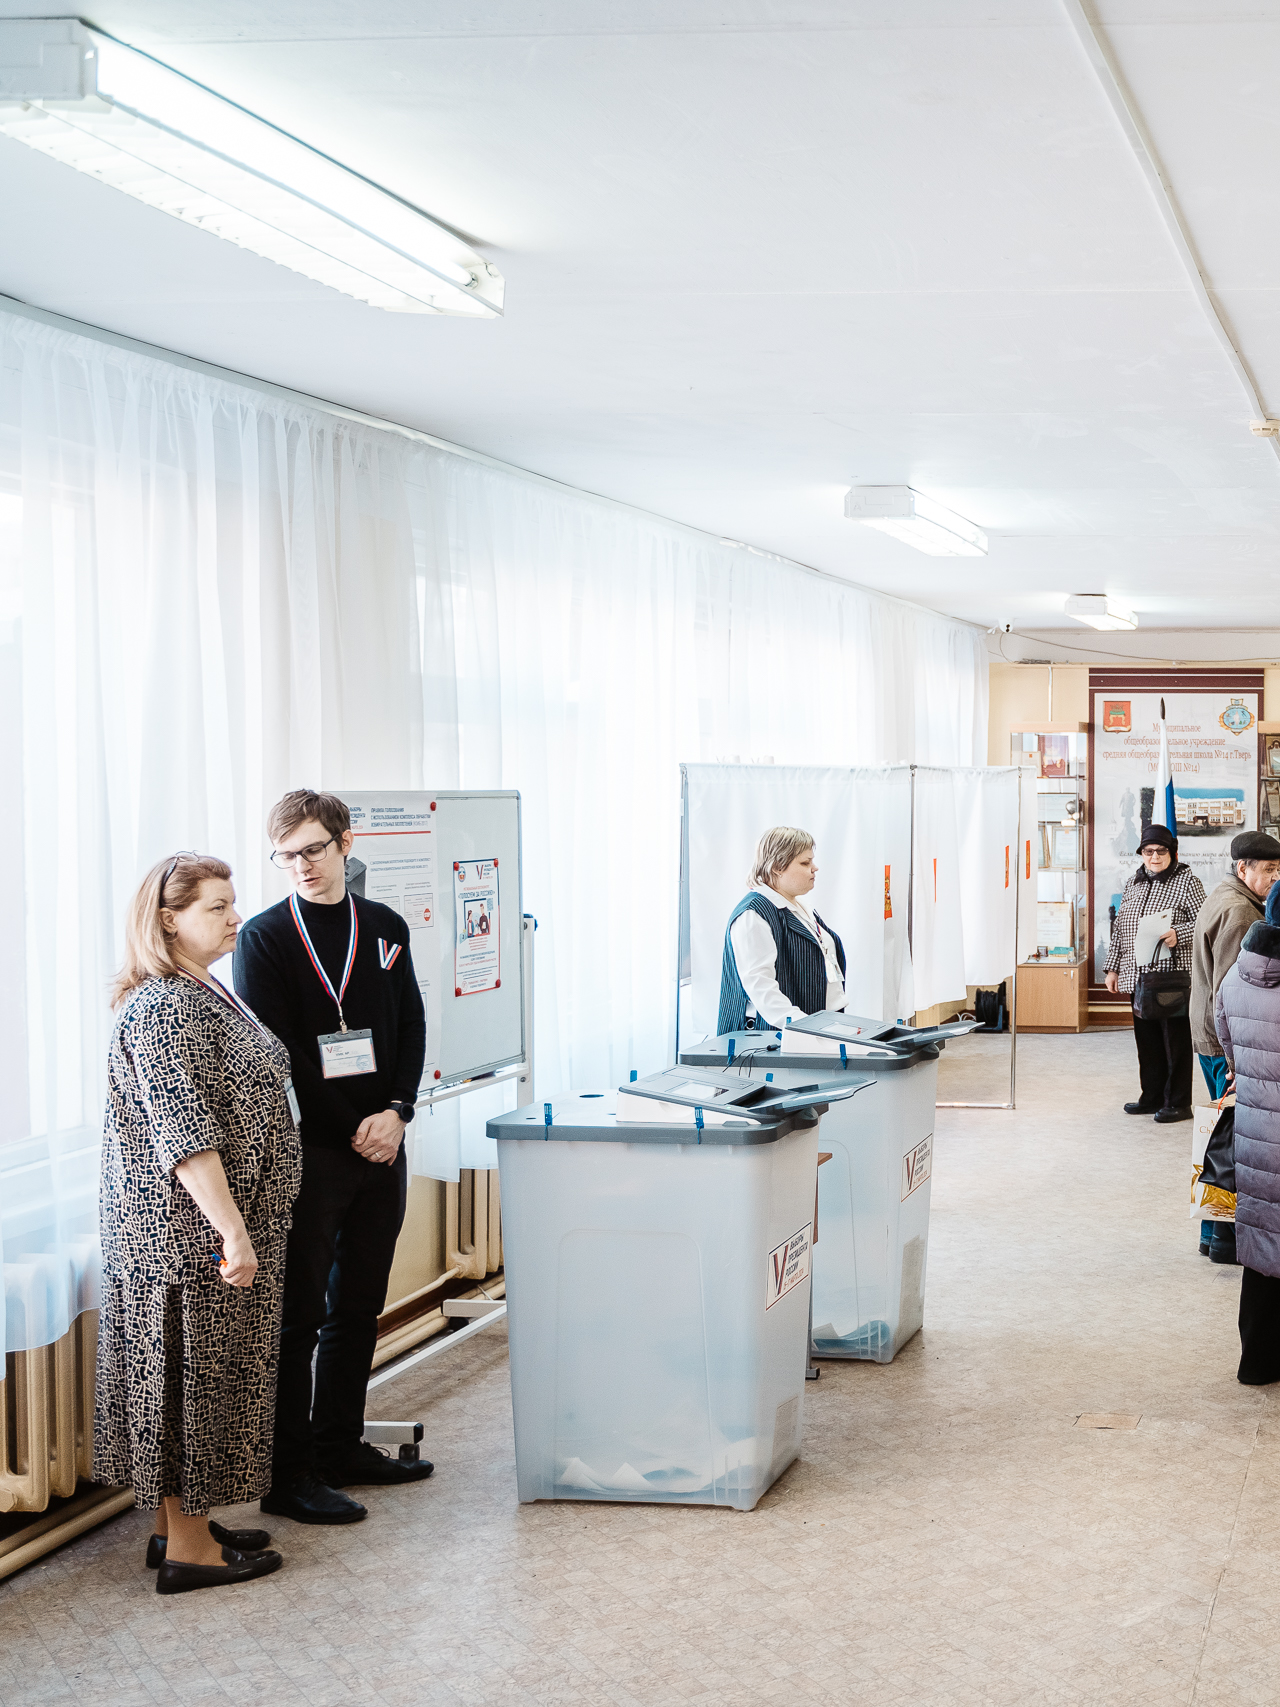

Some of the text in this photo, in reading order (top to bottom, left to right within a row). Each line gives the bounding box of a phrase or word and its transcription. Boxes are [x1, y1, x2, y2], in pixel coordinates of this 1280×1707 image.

[1190, 738, 1226, 748] учреждение
[1102, 751, 1127, 761] средняя
[1194, 751, 1213, 759] школа
[1214, 750, 1229, 761] №14
[1183, 762, 1201, 773] №14)
